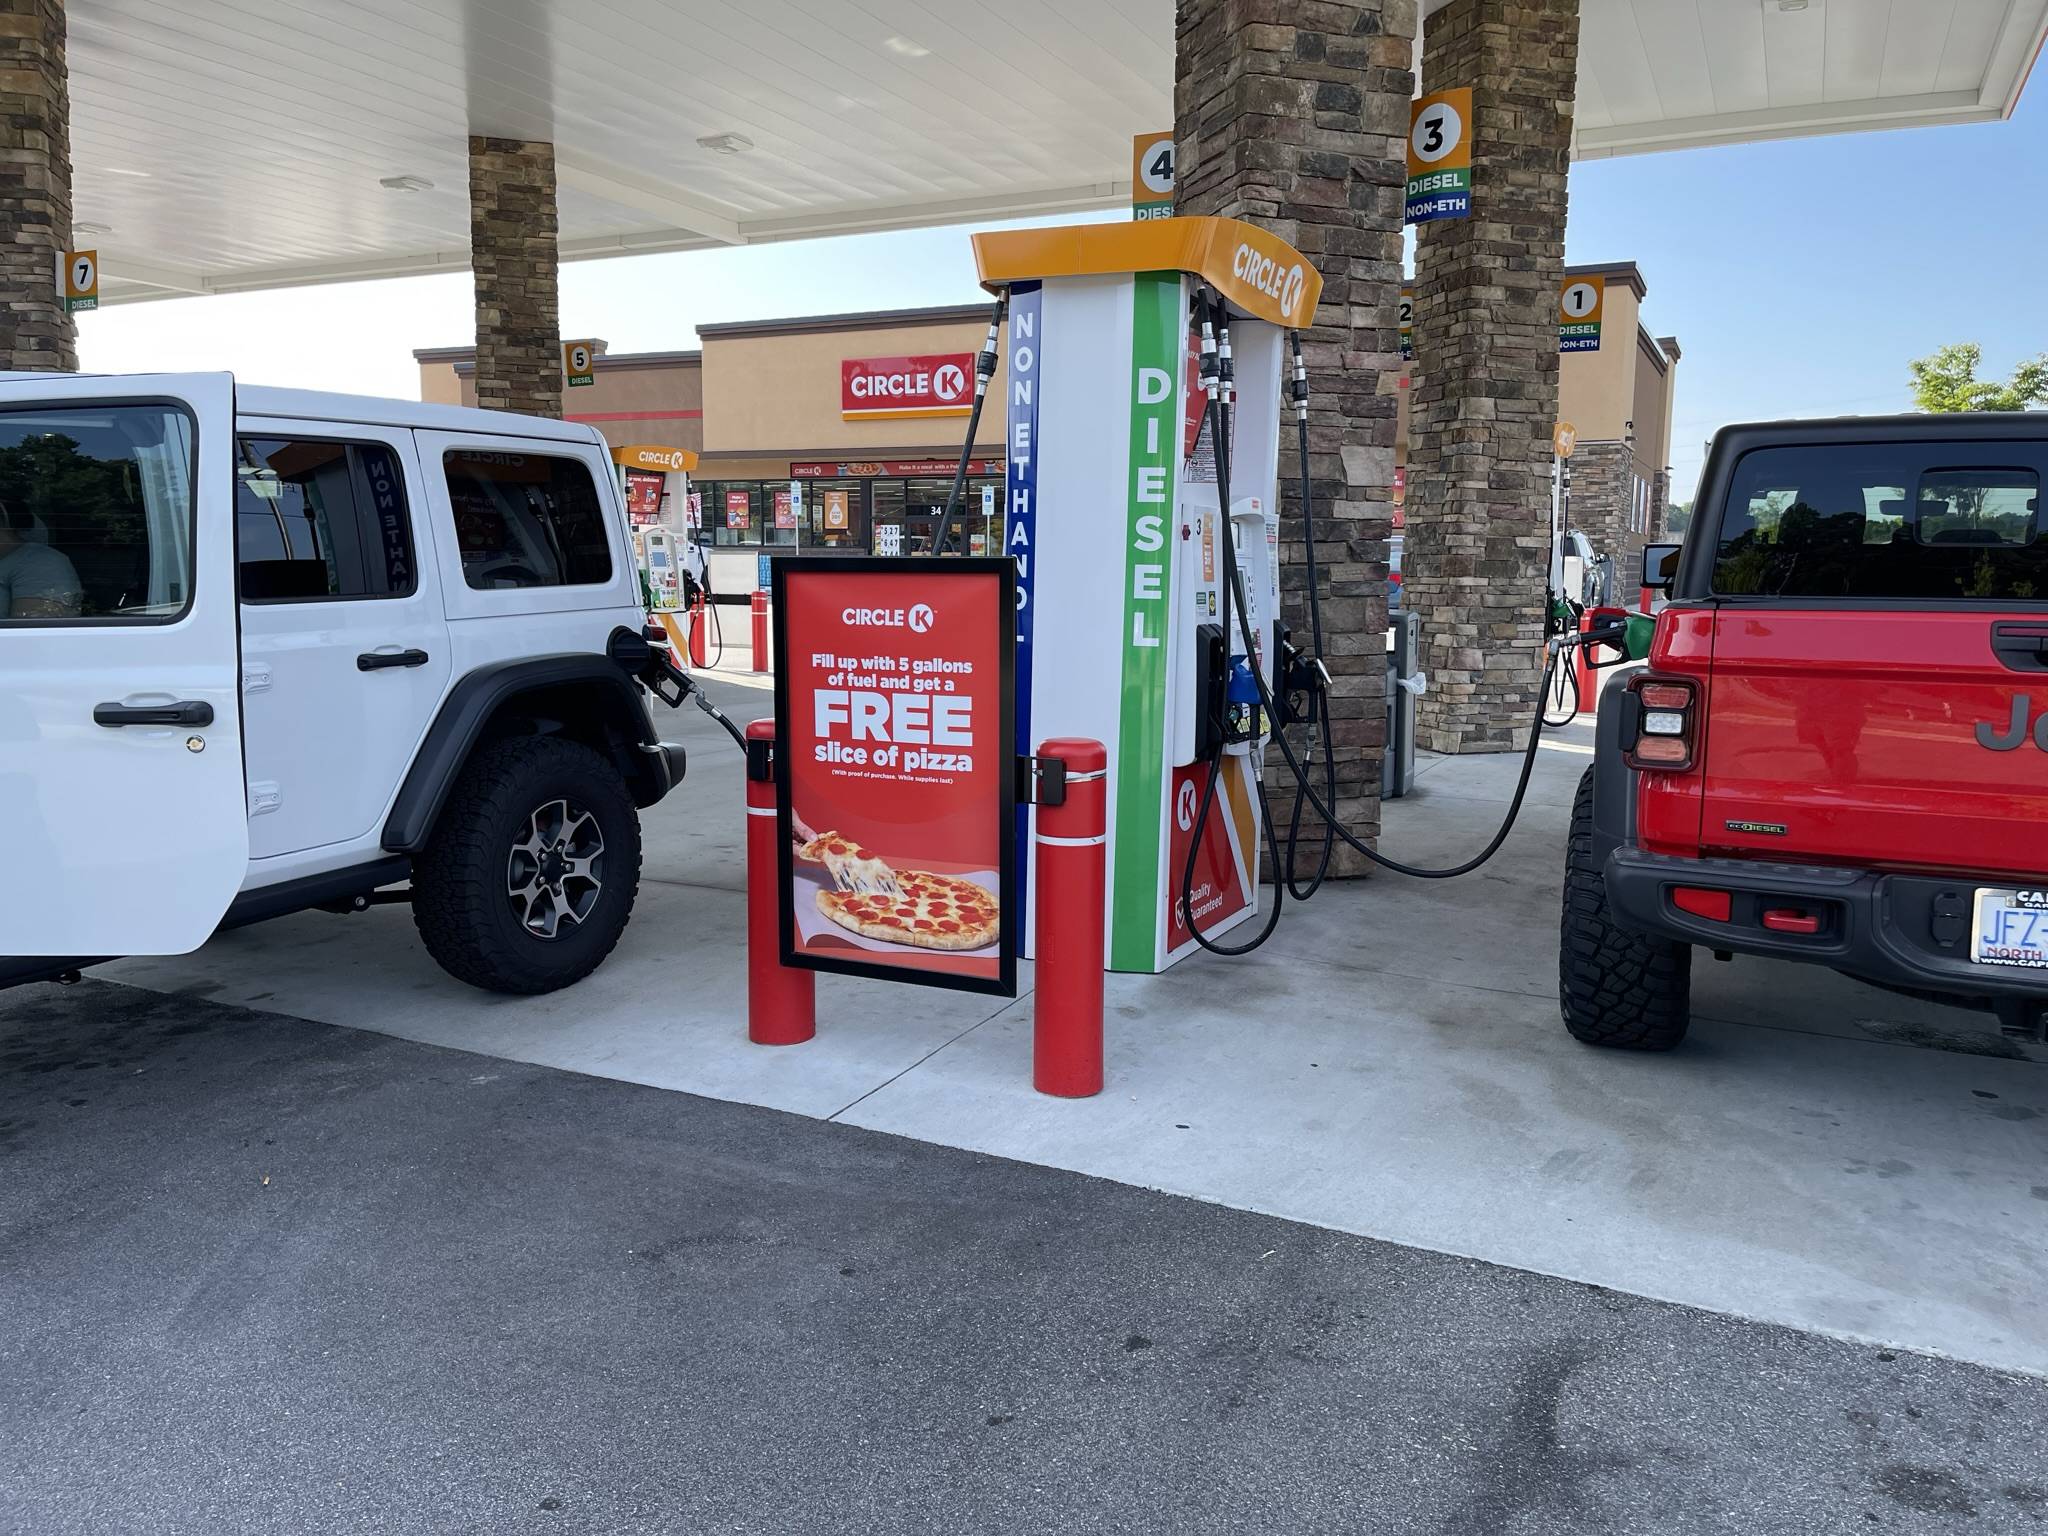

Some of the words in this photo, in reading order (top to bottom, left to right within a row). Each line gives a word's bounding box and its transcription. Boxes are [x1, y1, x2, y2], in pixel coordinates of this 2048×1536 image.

[1423, 118, 1443, 152] 3
[1150, 150, 1174, 180] 4
[1408, 174, 1463, 195] DIESEL
[1138, 206, 1174, 220] DIES
[1407, 199, 1466, 218] NON-ETH
[79, 265, 88, 284] 7
[1234, 244, 1283, 298] CIRCLE
[1282, 267, 1303, 315] K
[72, 299, 96, 309] DIESEL
[1573, 290, 1583, 309] 1
[1400, 303, 1411, 321] 2
[1560, 325, 1597, 335] DIESEL
[576, 352, 585, 366] 5
[1014, 312, 1033, 406] NON
[571, 377, 592, 385] DIESEL
[851, 373, 929, 397] CIRCLE
[936, 366, 963, 398] K
[639, 451, 670, 465] CIRCLE
[672, 454, 682, 467] K
[794, 467, 813, 475] CIRCLE
[931, 507, 942, 516] 34
[1132, 367, 1171, 647] DIESEL
[1011, 423, 1029, 643] ETHANO
[842, 608, 904, 626] CIRCLE
[911, 606, 932, 629] K
[812, 654, 834, 668] Fill
[837, 658, 857, 672] up
[861, 656, 895, 671] with
[899, 657, 909, 671] 5
[913, 658, 973, 674] gallons
[828, 672, 845, 686] of
[847, 673, 876, 688] fuel
[880, 675, 909, 689] and
[914, 678, 940, 692] get
[944, 680, 955, 691] a
[814, 689, 973, 747] FREE
[814, 741, 867, 765] slice
[872, 745, 899, 767] of
[904, 747, 973, 772] pizza
[1180, 783, 1196, 828] K
[1987, 947, 2042, 960] NORTH
